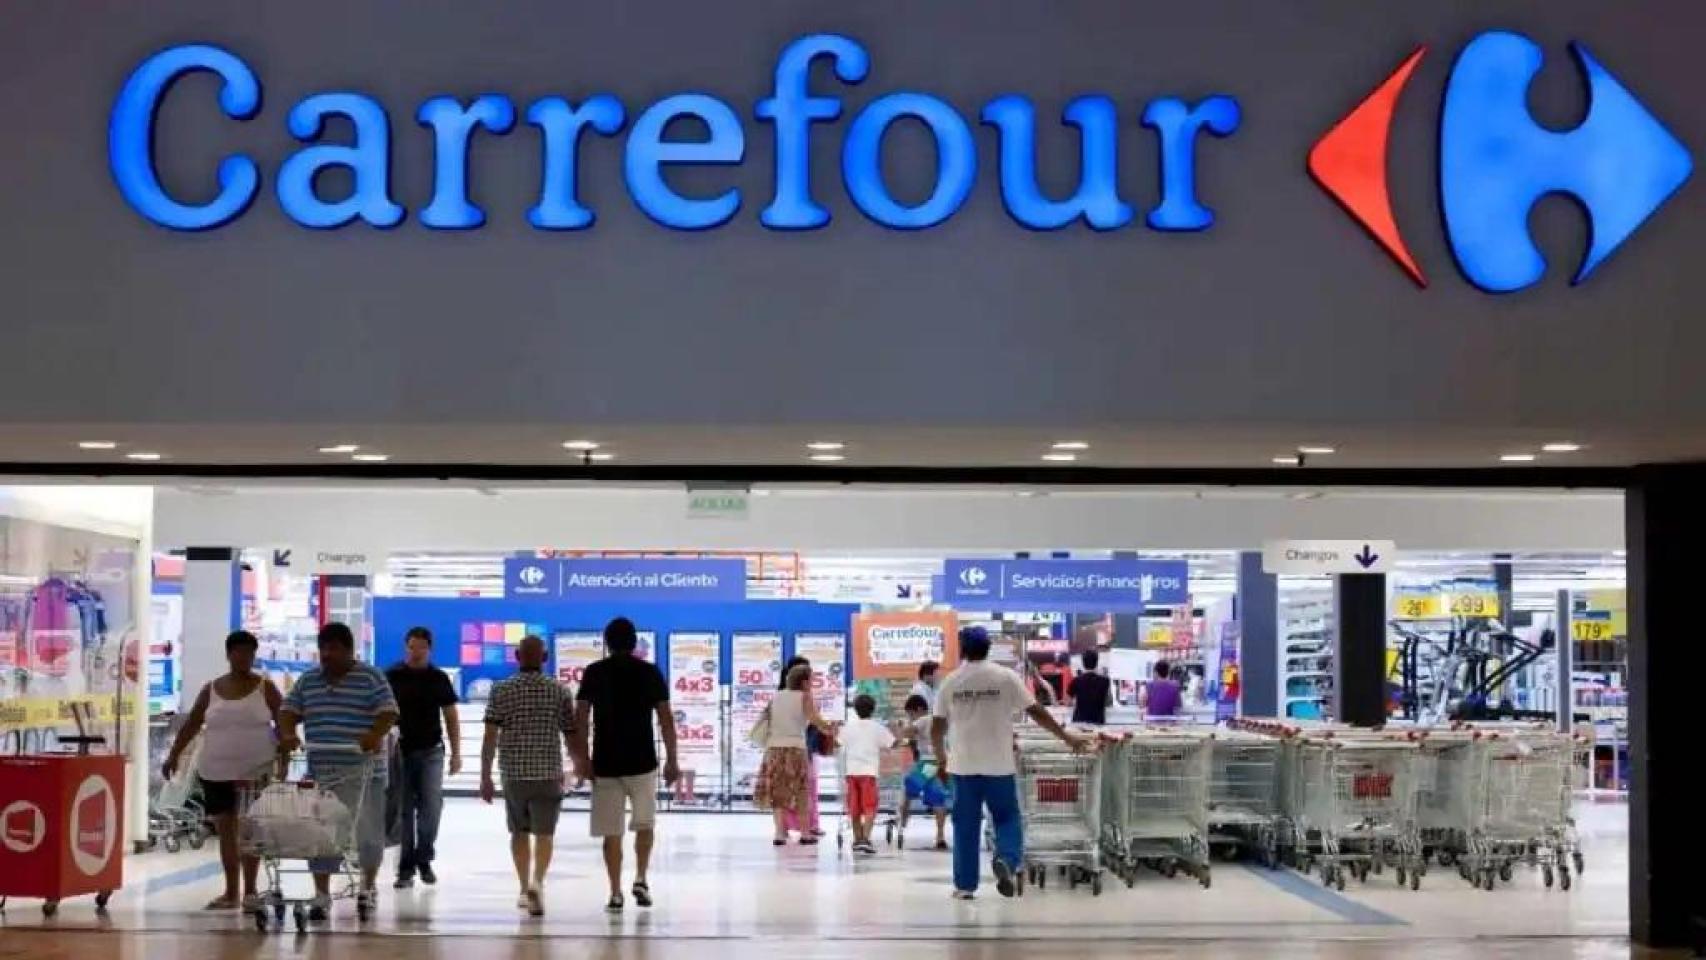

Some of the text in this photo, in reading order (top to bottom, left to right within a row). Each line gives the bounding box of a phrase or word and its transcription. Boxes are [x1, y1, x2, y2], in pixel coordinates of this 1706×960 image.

[107, 33, 1242, 232] Carrefour
[317, 551, 367, 565] Changos
[1285, 549, 1339, 563] Changos
[568, 570, 642, 587] Atención
[645, 572, 657, 587] al
[1011, 573, 1083, 589] Servicios
[872, 626, 938, 640] Carrefour
[675, 677, 714, 692] 4x3
[678, 725, 714, 739] 3x2
